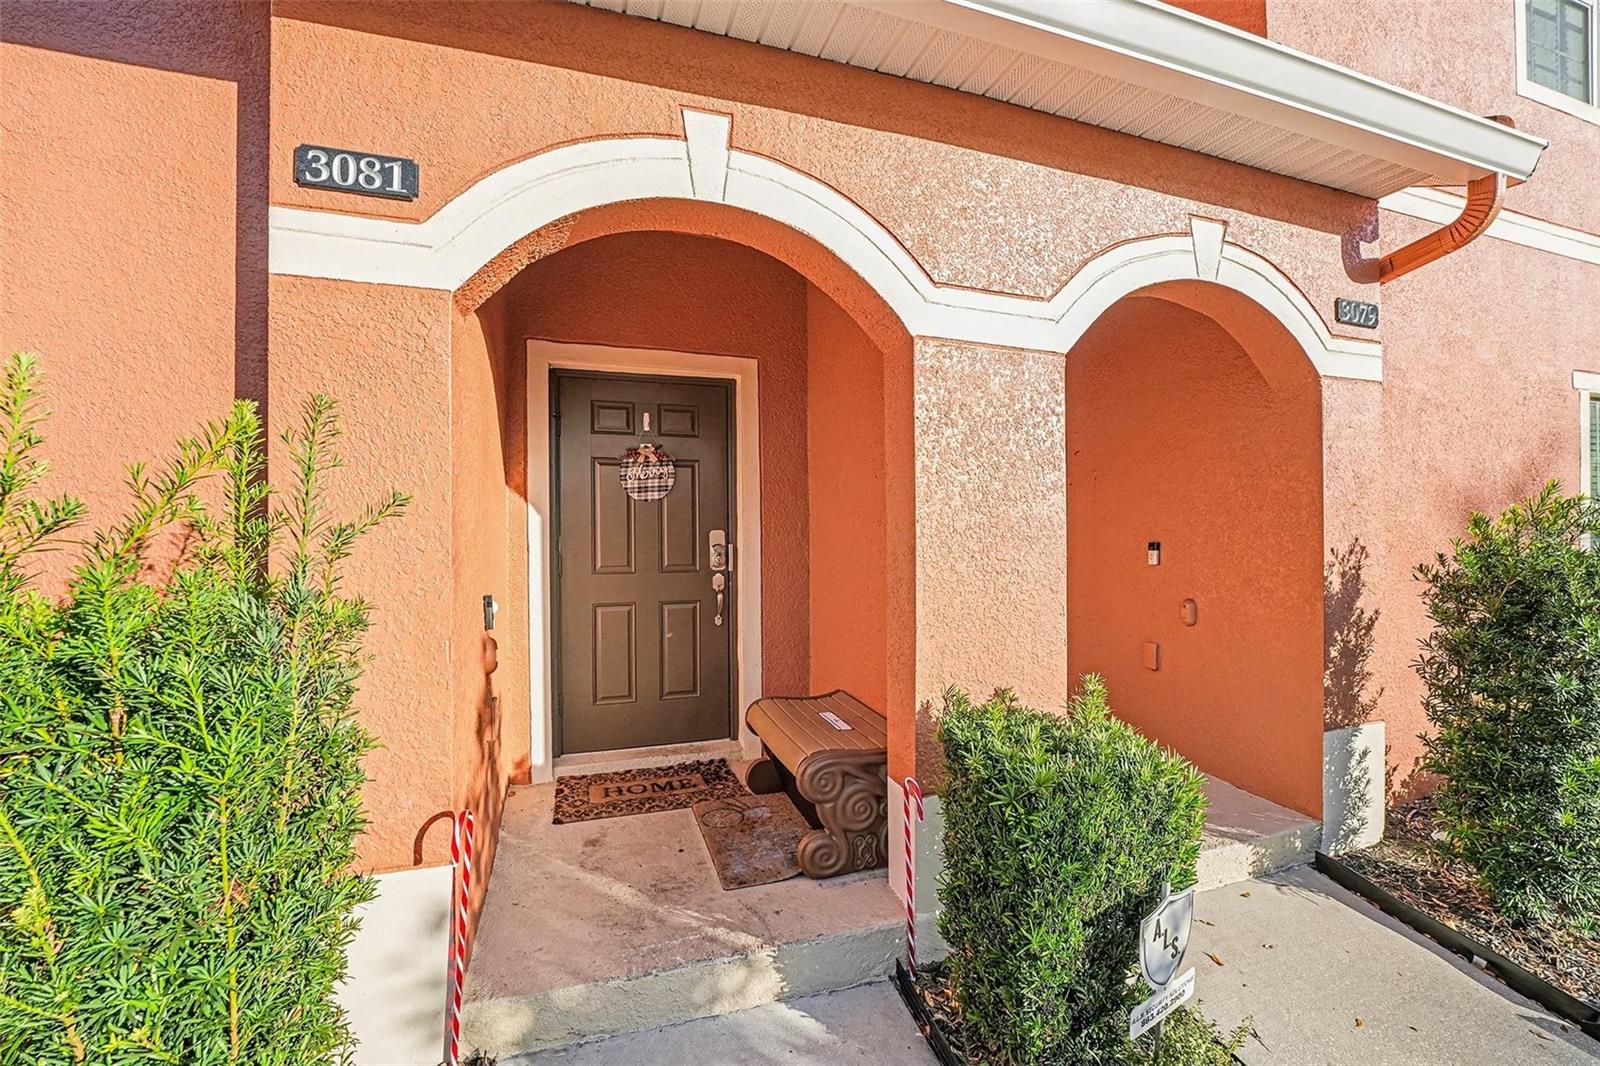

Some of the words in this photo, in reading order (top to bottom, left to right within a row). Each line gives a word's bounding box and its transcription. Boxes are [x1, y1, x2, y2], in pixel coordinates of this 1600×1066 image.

[305, 149, 407, 193] 3081
[1340, 301, 1376, 325] 3079
[626, 464, 668, 481] Merry
[604, 779, 698, 797] HOME
